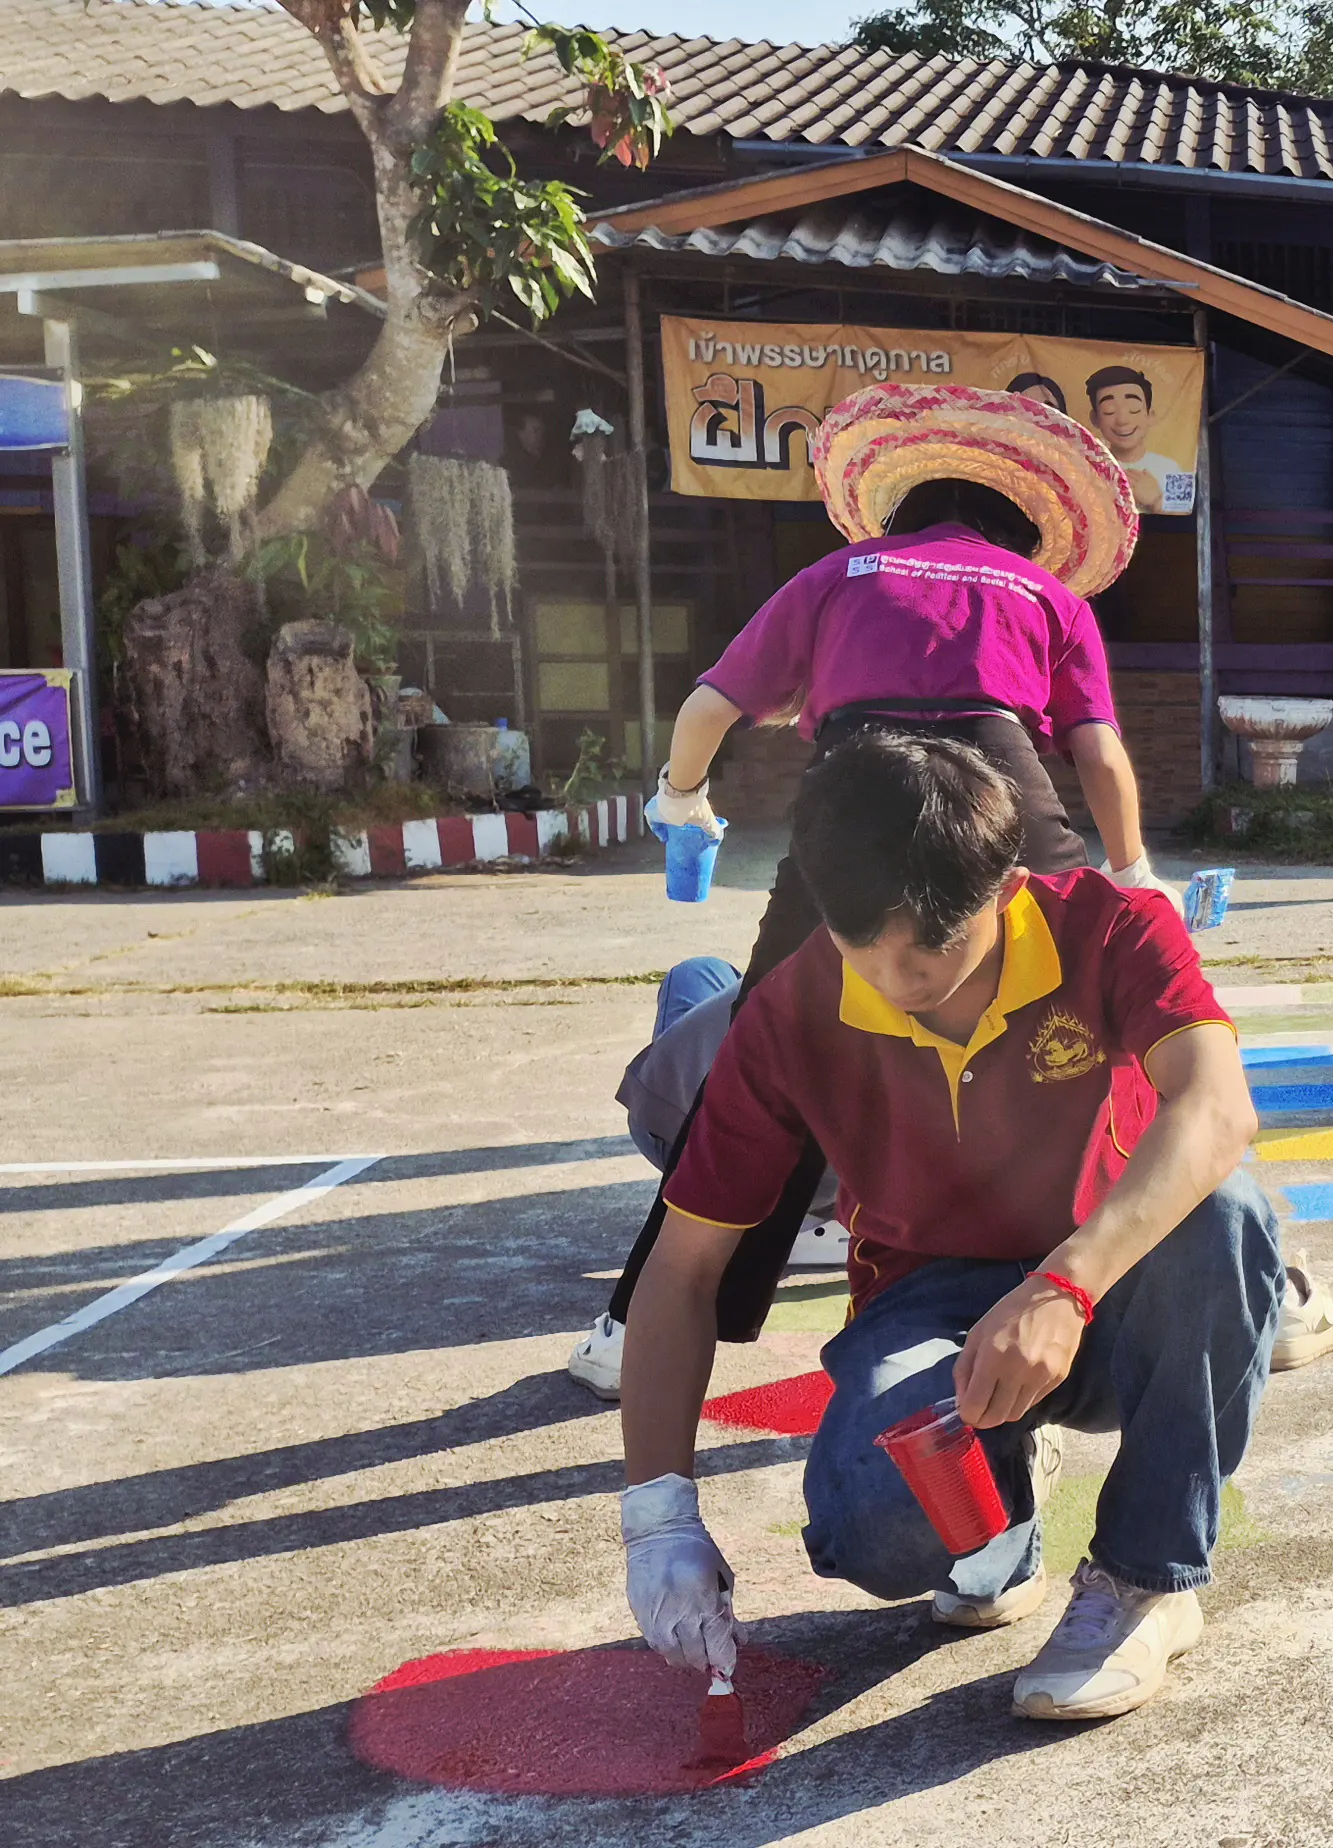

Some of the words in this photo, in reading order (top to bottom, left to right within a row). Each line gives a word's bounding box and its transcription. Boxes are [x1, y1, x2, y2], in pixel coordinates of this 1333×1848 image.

[689, 331, 951, 382] เข้าพรรษาฤดูกาล
